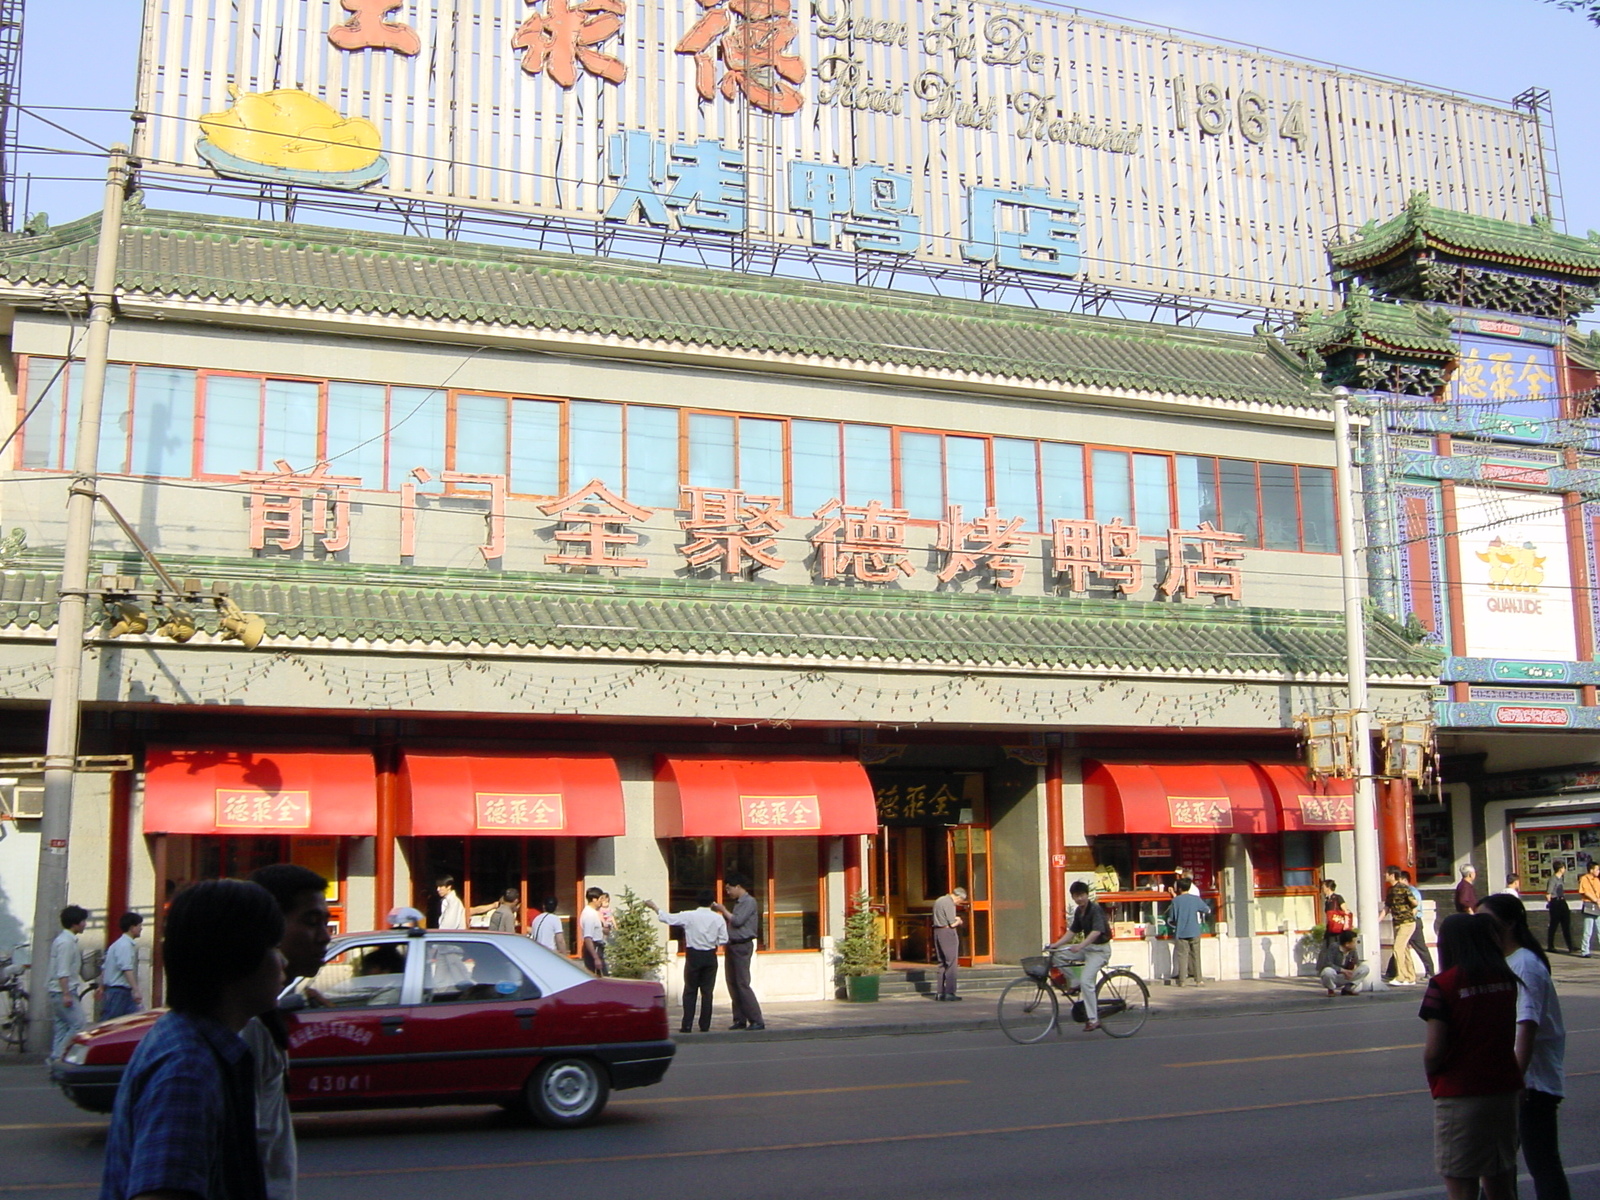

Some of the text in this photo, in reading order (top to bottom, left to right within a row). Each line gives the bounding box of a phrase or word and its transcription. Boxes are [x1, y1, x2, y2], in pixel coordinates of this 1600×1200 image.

[982, 14, 1046, 73] De
[816, 54, 905, 116] Roast
[914, 68, 999, 131] Duck
[1173, 75, 1308, 154] 1864
[604, 128, 1080, 279] 烤鸭店
[239, 457, 1246, 600] 前门全聚德烤鸭店
[1487, 597, 1543, 615] QUANJUDE
